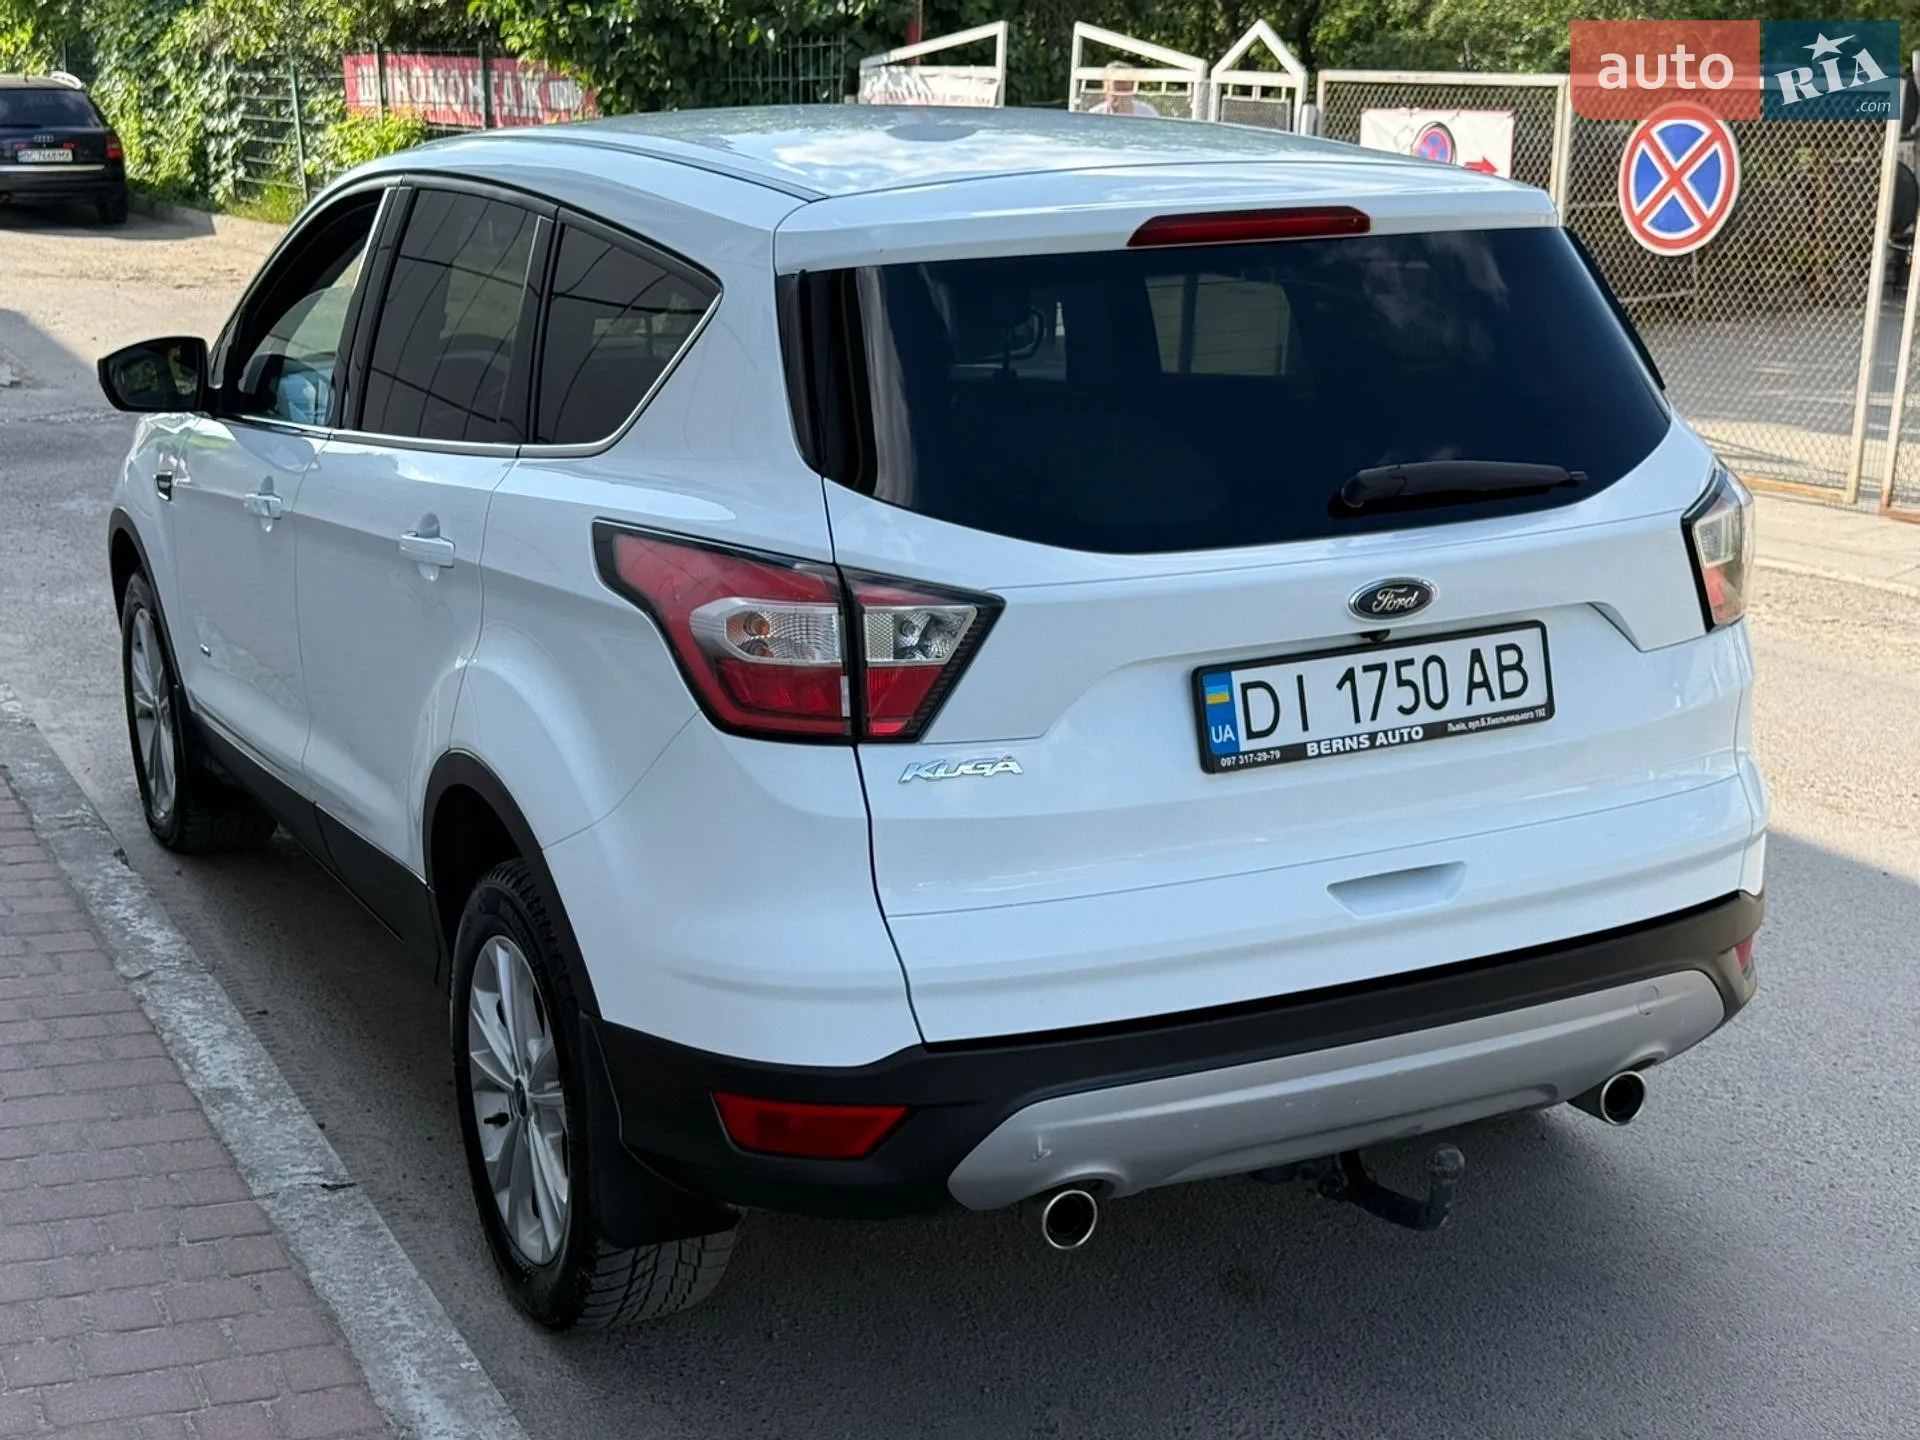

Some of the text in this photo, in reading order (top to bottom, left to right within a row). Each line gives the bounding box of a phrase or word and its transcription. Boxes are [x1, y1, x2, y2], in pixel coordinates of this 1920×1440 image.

[1371, 587, 1420, 613] Ford
[1241, 643, 1529, 741] DI 1750 AB
[1211, 724, 1236, 744] UA
[1306, 726, 1424, 757] BERNS AUTO
[898, 753, 1023, 784] KUGA
[1221, 756, 1236, 768] 097
